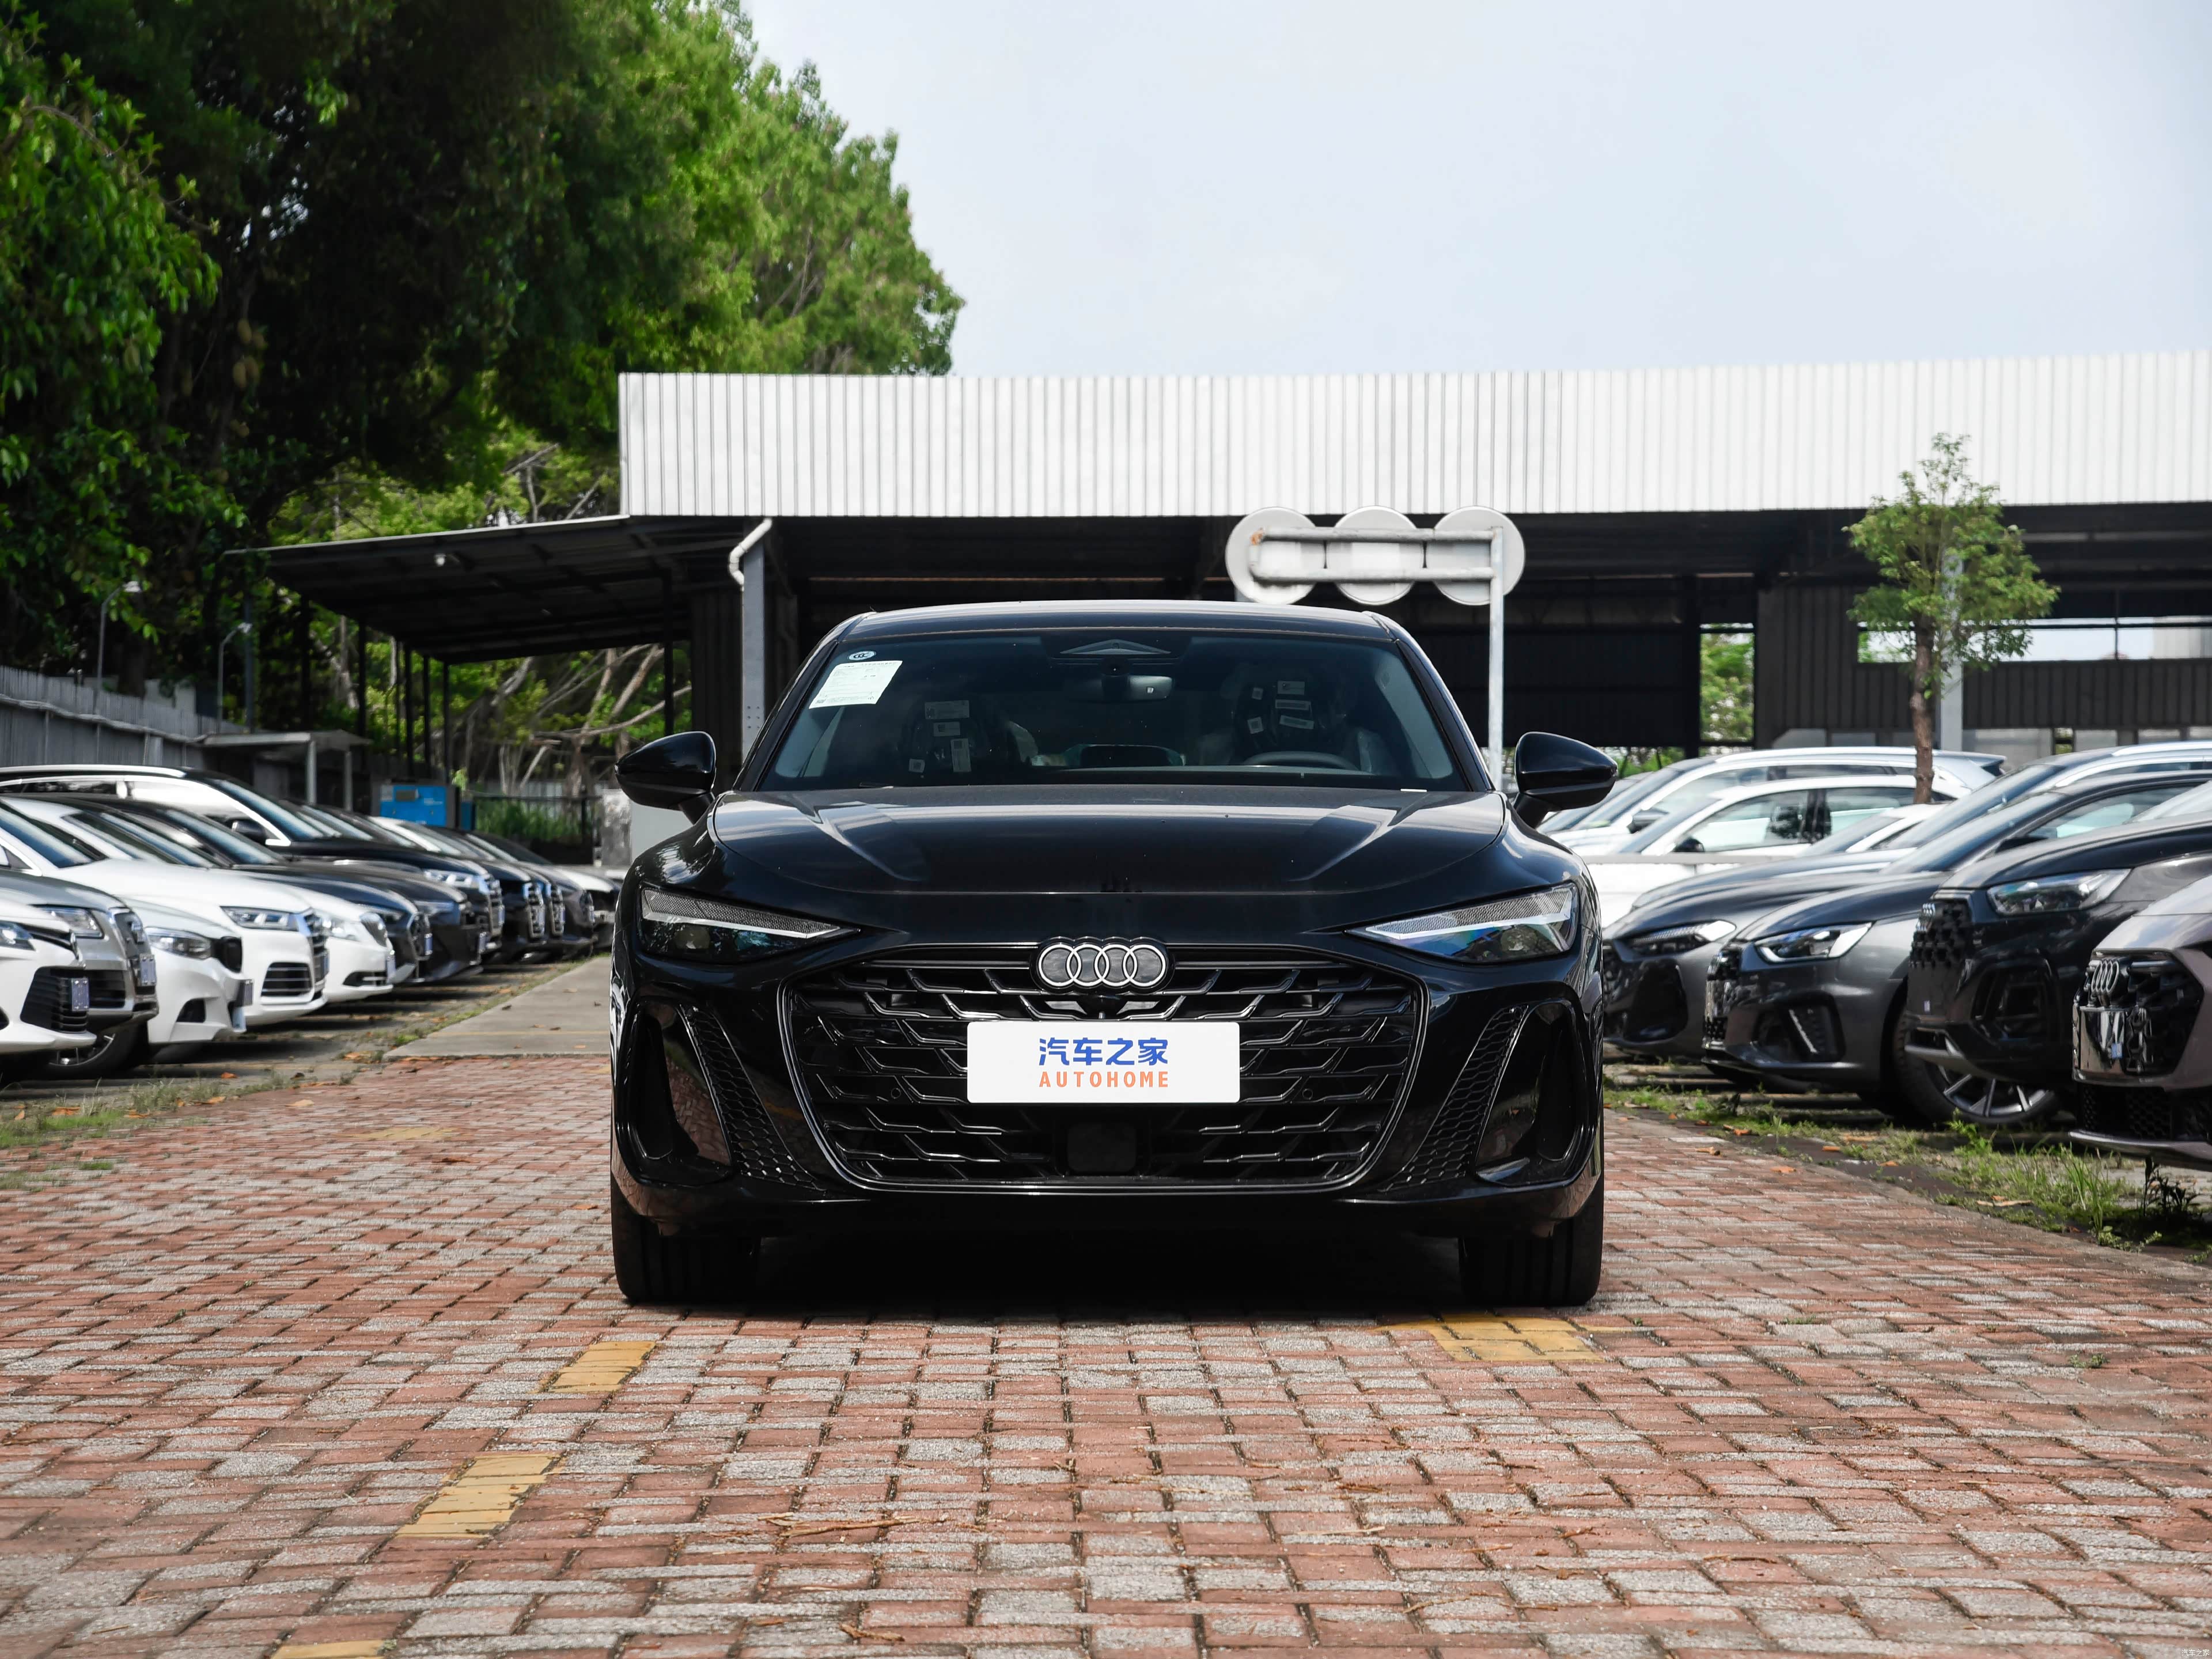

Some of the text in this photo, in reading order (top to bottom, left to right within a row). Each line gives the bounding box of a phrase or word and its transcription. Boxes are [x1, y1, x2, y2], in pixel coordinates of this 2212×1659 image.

[1039, 1037, 1168, 1066] 汽车之家
[1039, 1071, 1168, 1088] AUTOHOME
